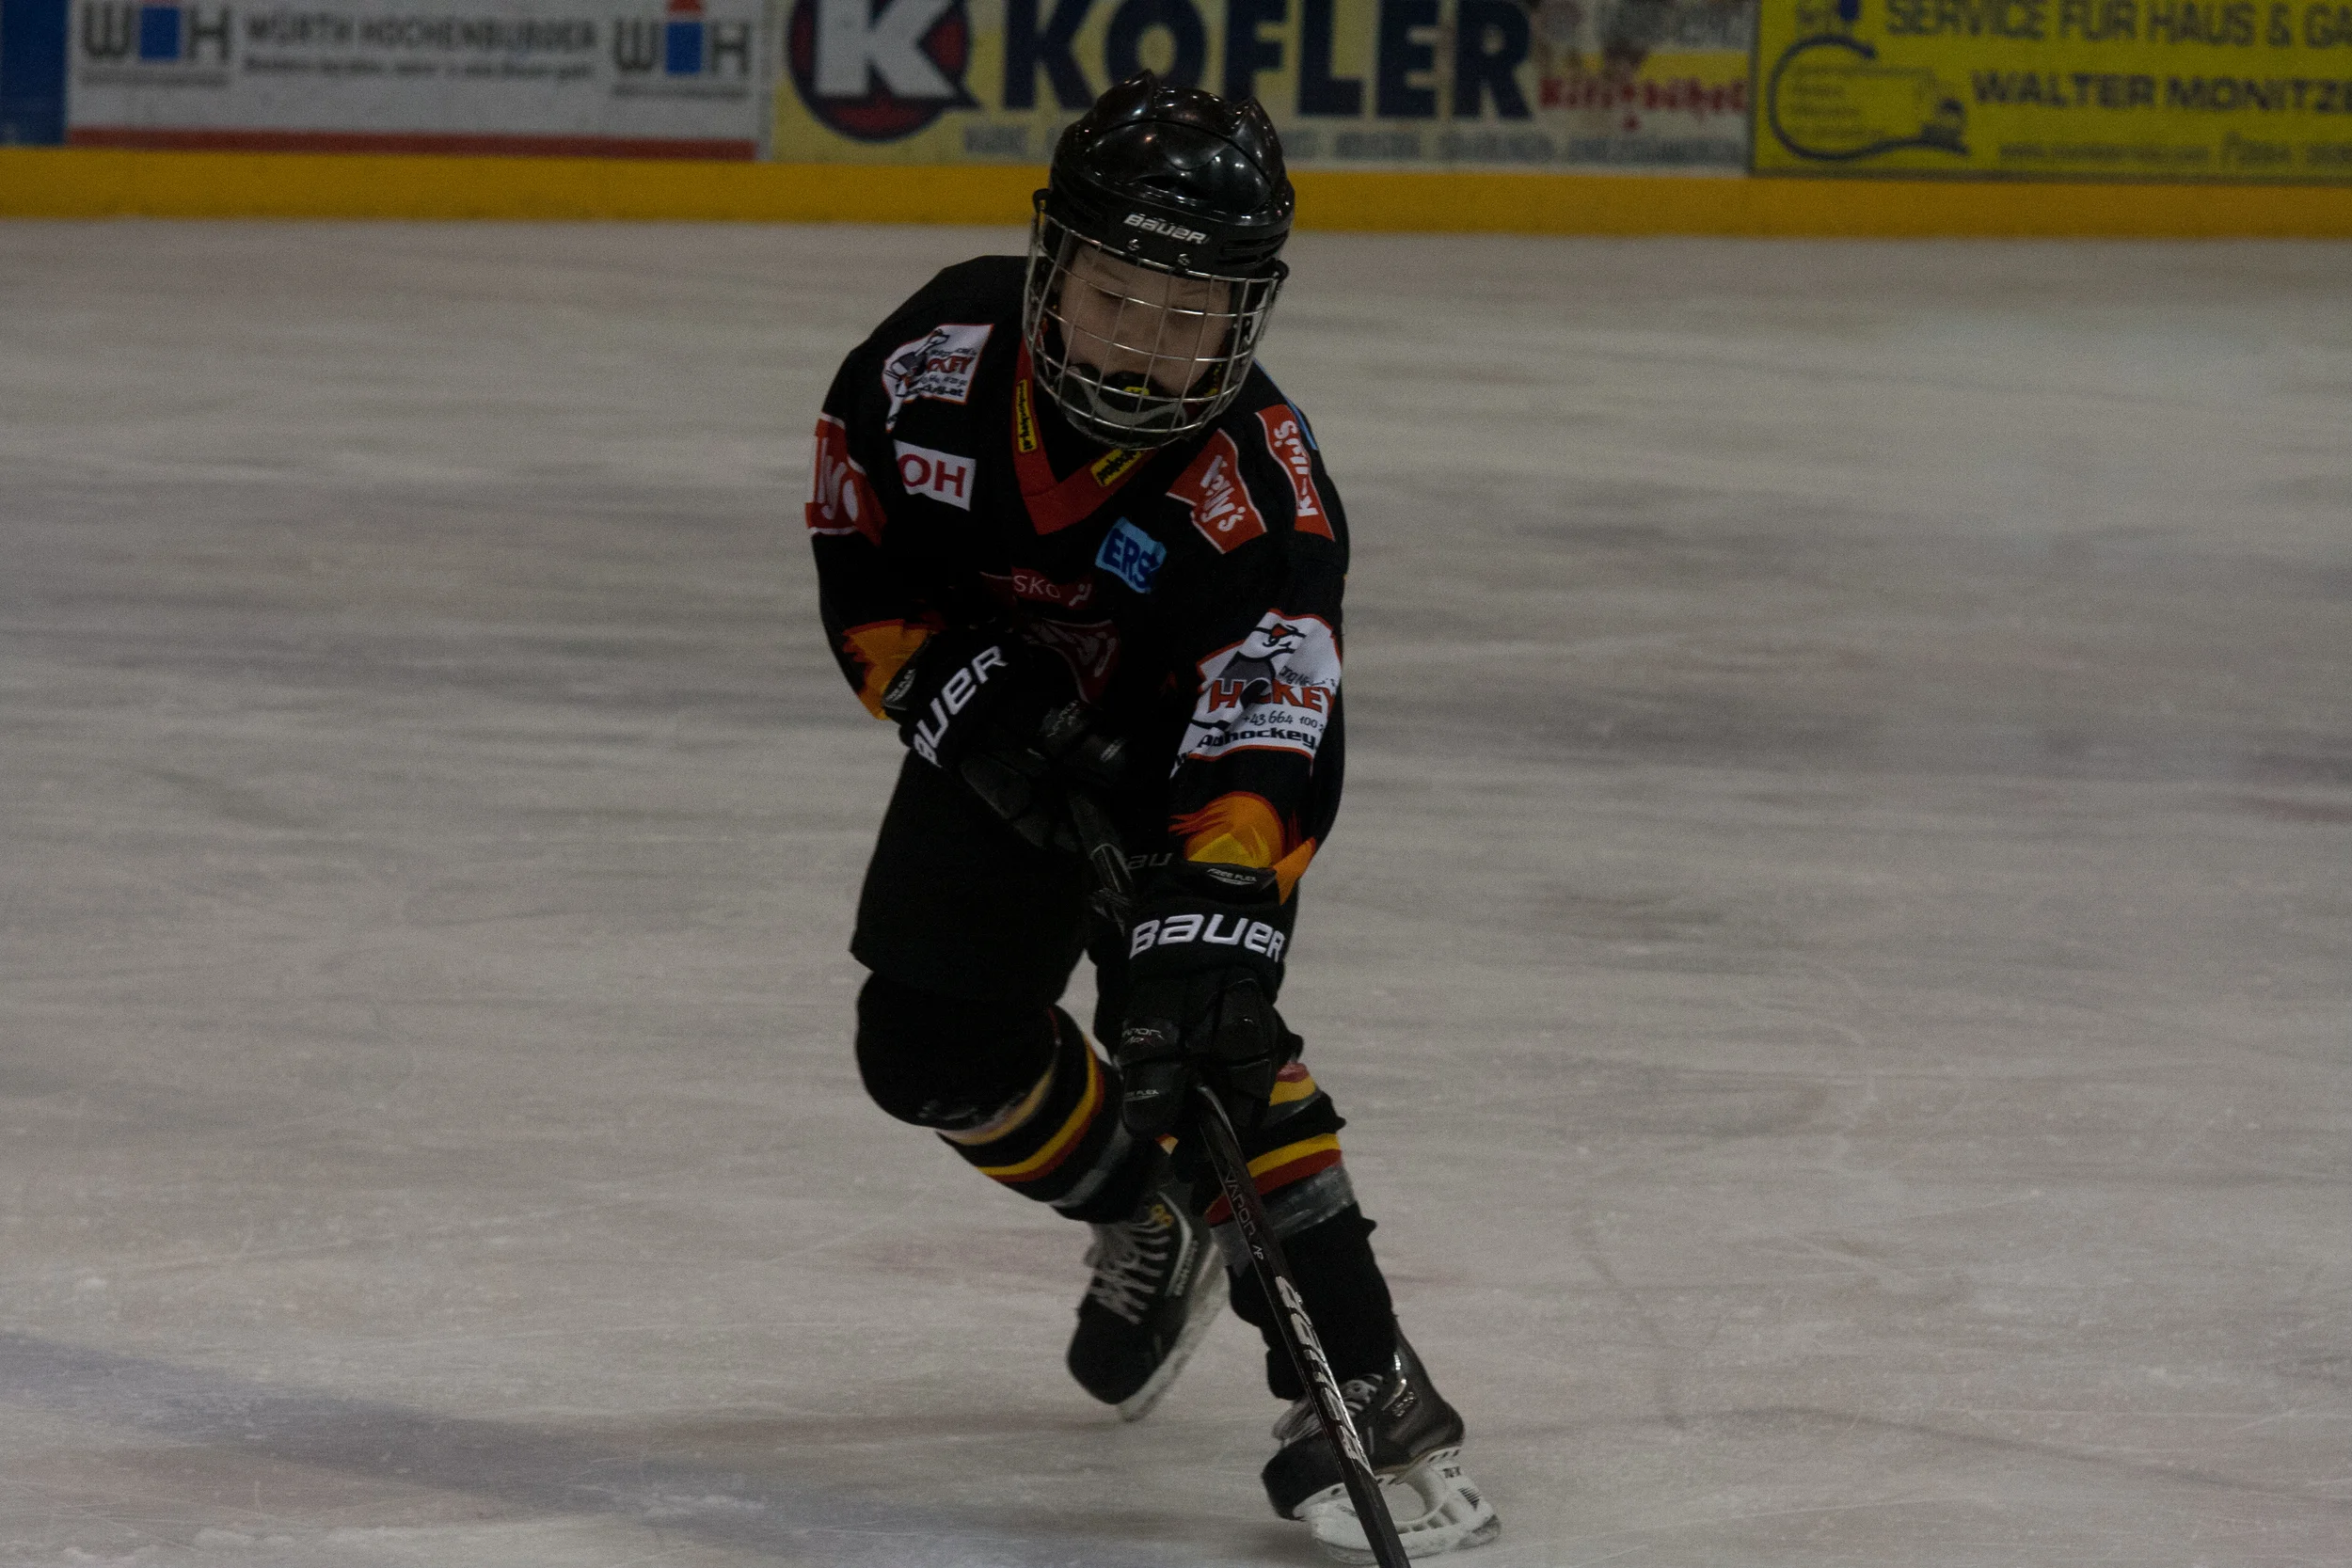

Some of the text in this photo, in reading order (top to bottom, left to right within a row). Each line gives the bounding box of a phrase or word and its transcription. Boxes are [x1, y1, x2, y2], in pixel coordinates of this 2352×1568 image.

[2148, 0, 2256, 47] HAUS
[1006, 0, 1534, 117] KOFLER
[1972, 71, 2155, 108] WALTER
[1123, 214, 1211, 245] BAUER
[910, 645, 1009, 769] AUER
[1129, 912, 1285, 962] BAUER
